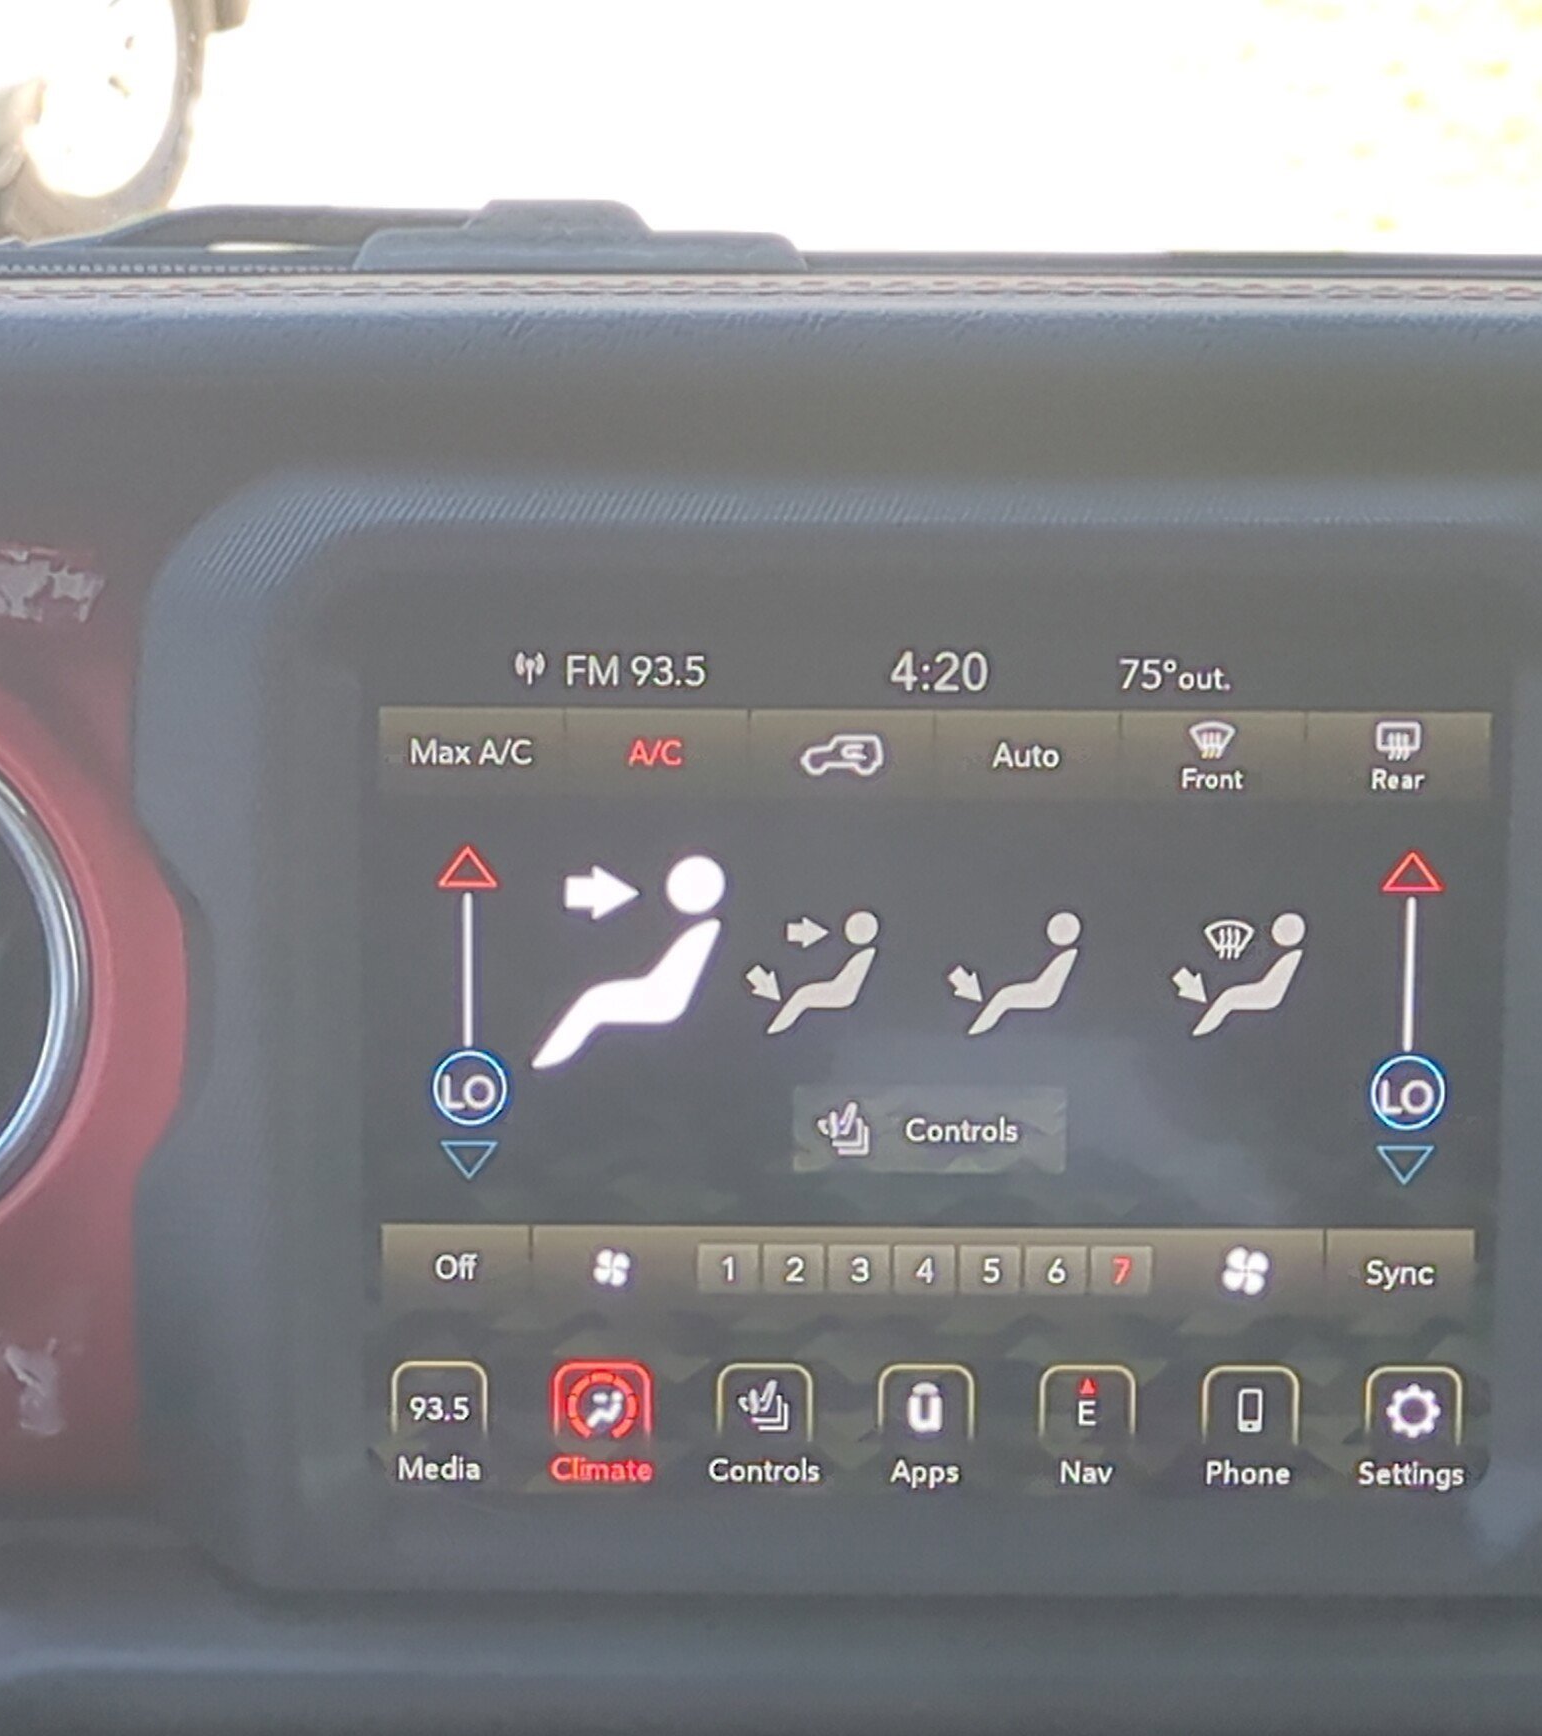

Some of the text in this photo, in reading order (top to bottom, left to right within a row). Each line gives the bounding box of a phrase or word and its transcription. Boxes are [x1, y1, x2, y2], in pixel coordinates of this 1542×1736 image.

[566, 655, 706, 686] FM 93.5
[891, 651, 989, 692] 4:20
[410, 738, 533, 767] Max A/C
[629, 739, 683, 767] A/C
[992, 742, 1060, 770] Auto
[1182, 768, 1243, 790] Front
[1371, 769, 1425, 790] Rear
[442, 1073, 497, 1111] LO
[1379, 1079, 1434, 1115] LO
[905, 1117, 1019, 1144] Controls
[435, 1254, 479, 1281] Off
[722, 1257, 1132, 1284] 1 2 3 4 5 6 7
[1366, 1260, 1434, 1289] Sync
[409, 1396, 470, 1421] 93.5
[1077, 1400, 1096, 1427] E
[398, 1456, 481, 1481] Media
[551, 1456, 652, 1482] Climate
[709, 1457, 821, 1483] Controls
[890, 1459, 959, 1490] Apps
[1060, 1460, 1113, 1485] Nav
[1206, 1460, 1290, 1486] Phone
[1358, 1461, 1465, 1492] Settings
